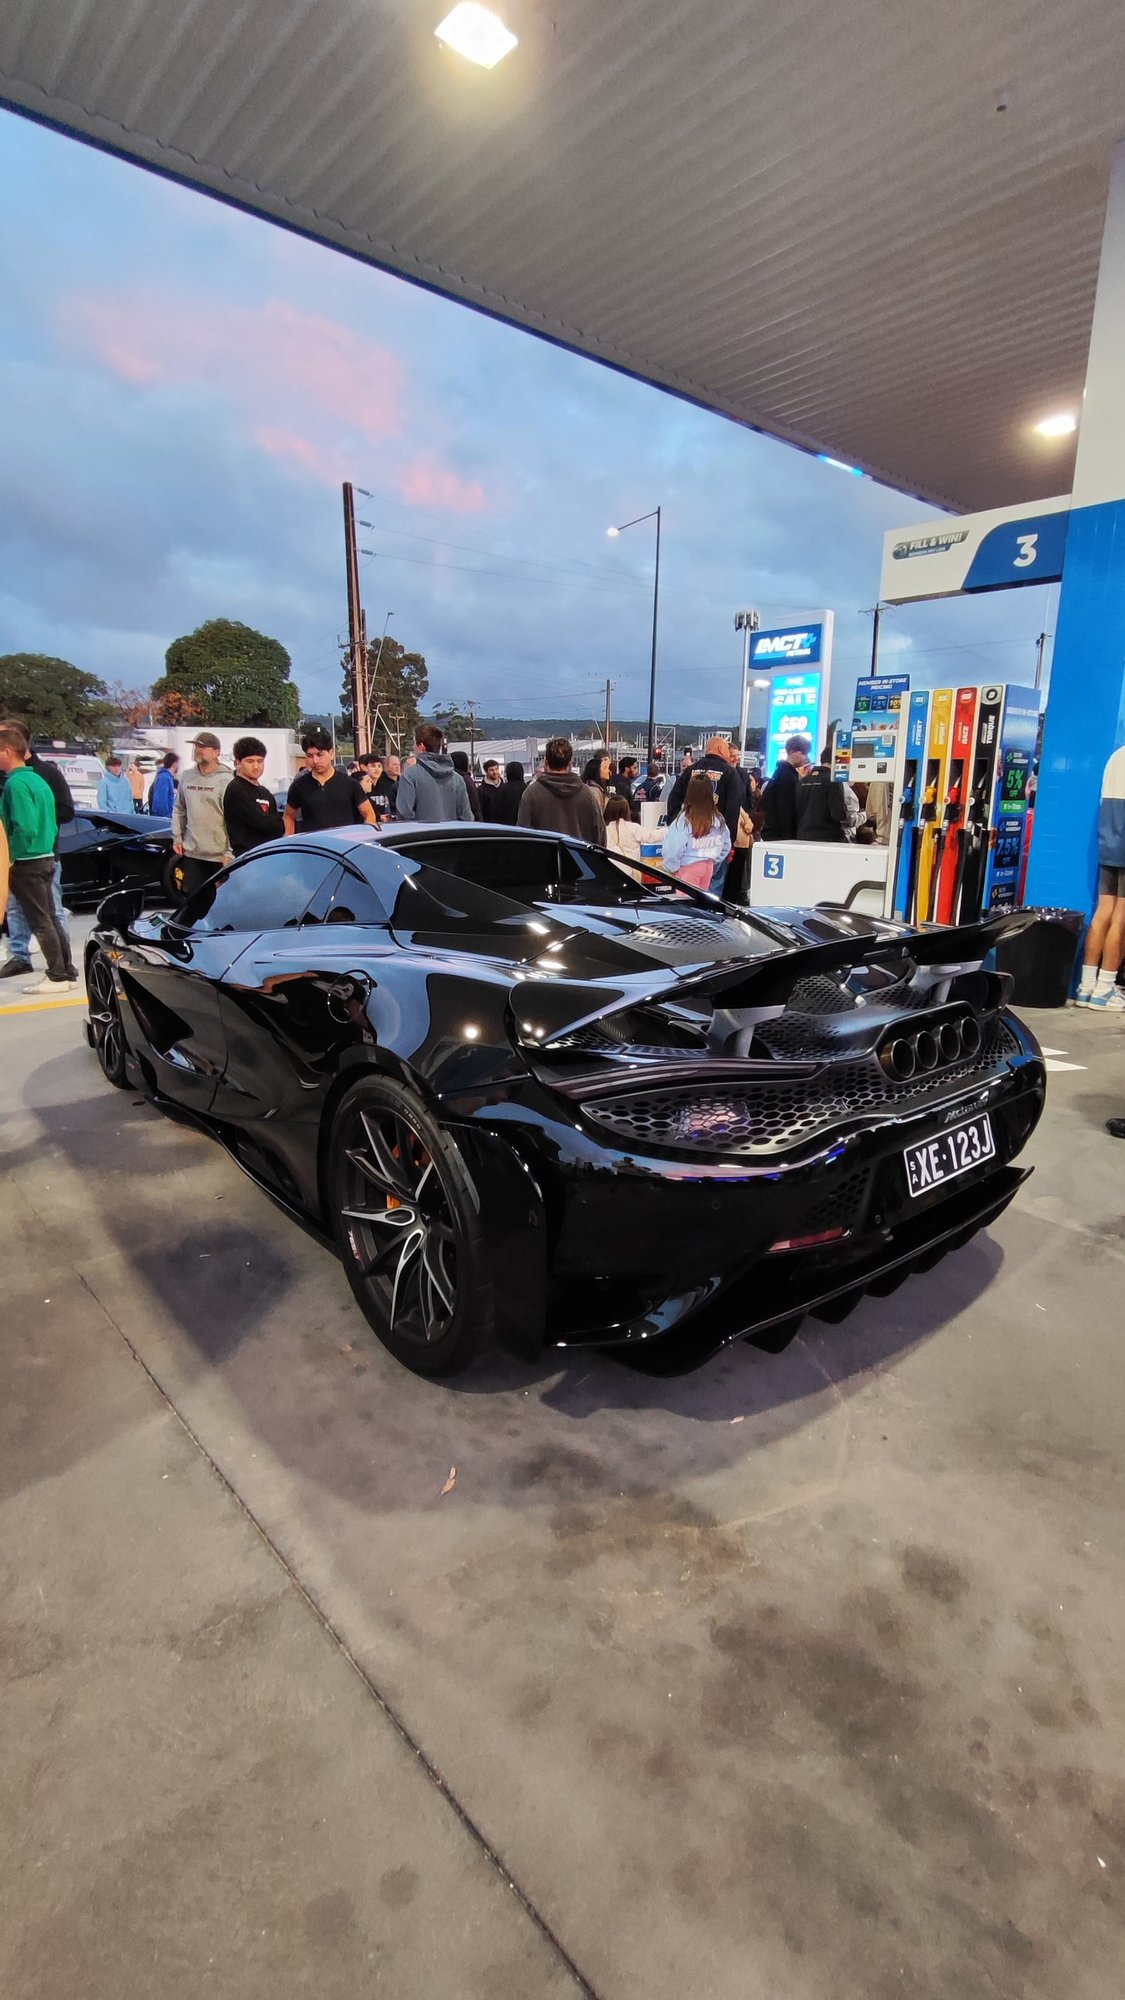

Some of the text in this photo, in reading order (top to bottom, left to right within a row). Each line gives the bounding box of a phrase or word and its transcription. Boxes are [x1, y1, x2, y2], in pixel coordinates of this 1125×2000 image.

[910, 533, 963, 550] FILL & WIN!
[1013, 533, 1038, 567] 3
[779, 715, 808, 733] $50
[986, 715, 995, 744] TORQUE
[961, 726, 969, 745] RACE
[1007, 770, 1023, 789] 5%
[997, 838, 1019, 856] 7.5%
[768, 858, 780, 876] 3
